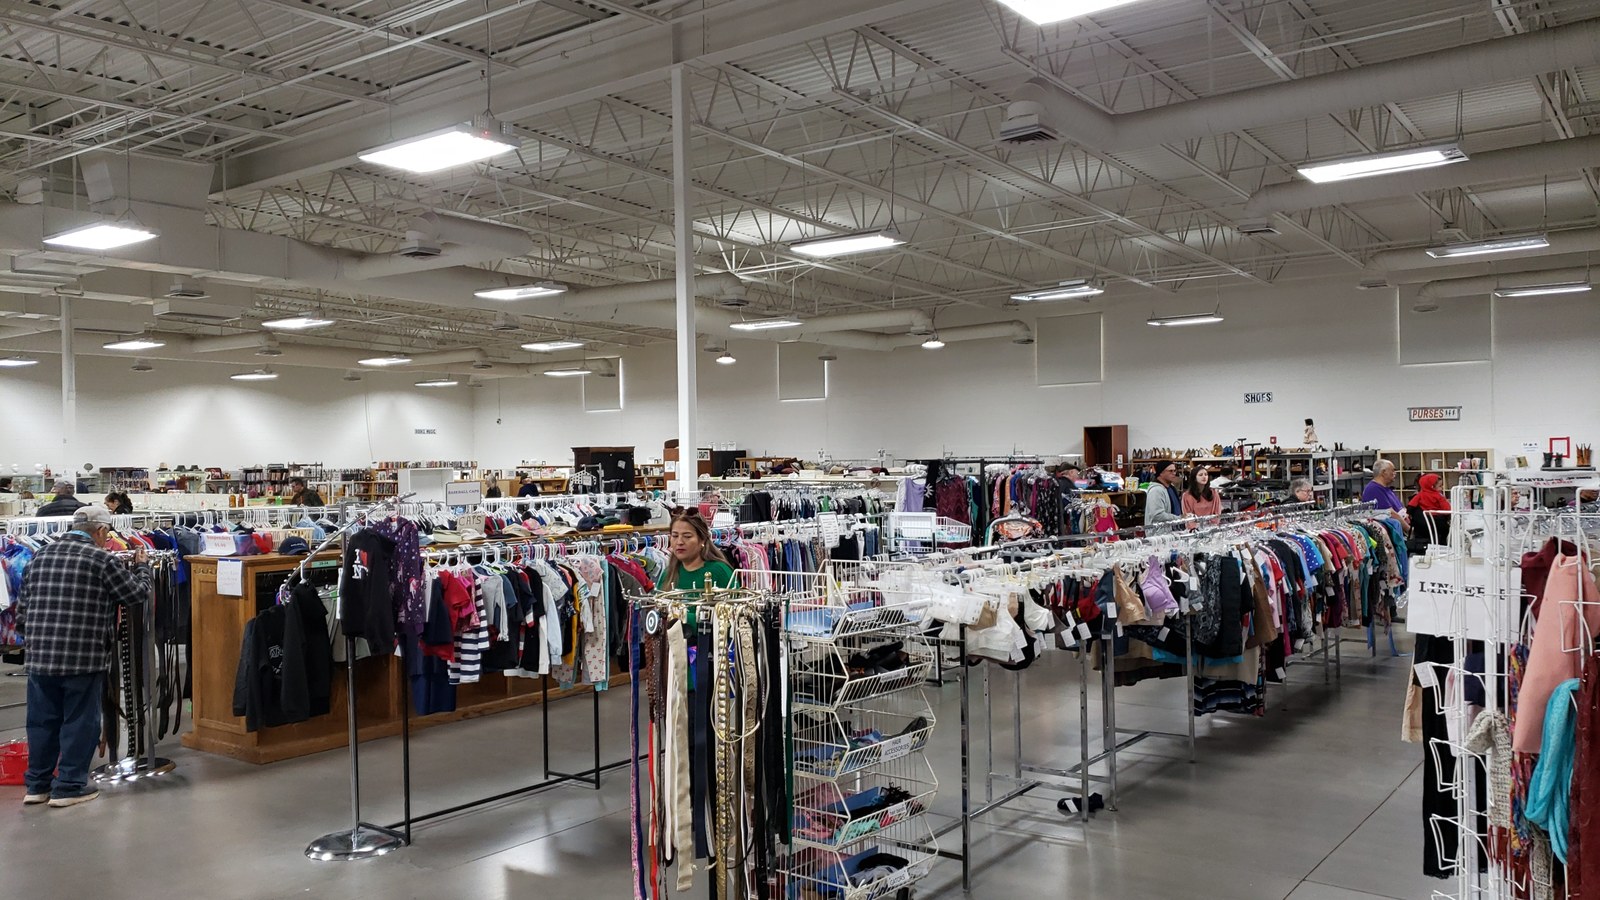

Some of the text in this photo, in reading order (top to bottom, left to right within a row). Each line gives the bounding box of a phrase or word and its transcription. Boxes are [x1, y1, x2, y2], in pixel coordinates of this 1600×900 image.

[1245, 393, 1271, 403] SHOES
[1412, 409, 1444, 418] PURSES
[458, 515, 482, 526] CAPS
